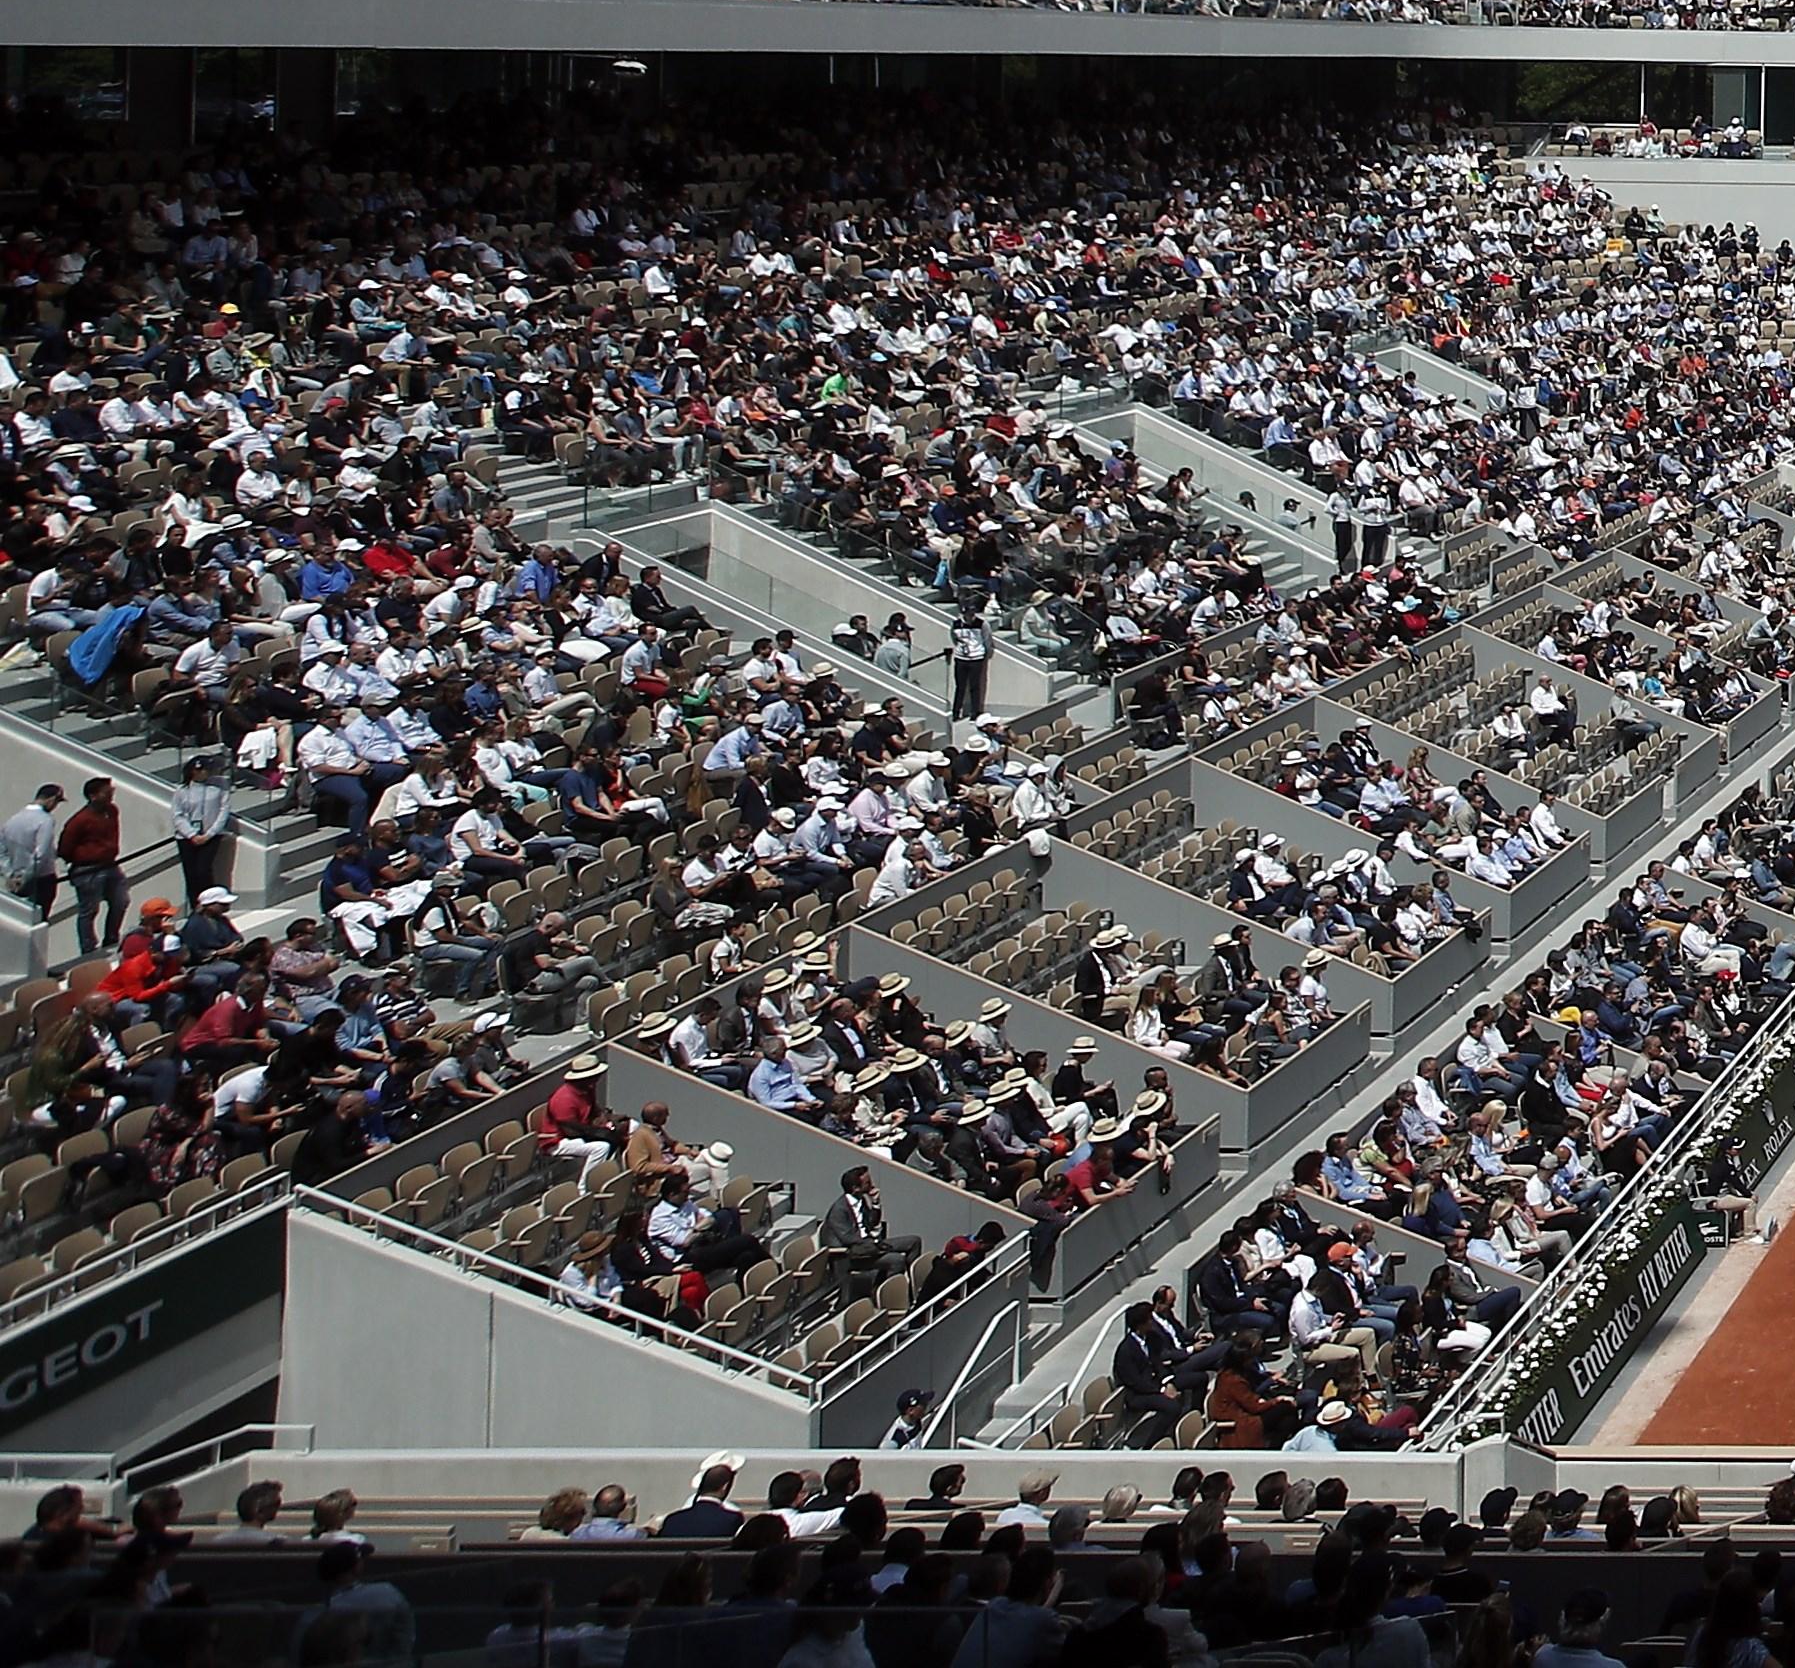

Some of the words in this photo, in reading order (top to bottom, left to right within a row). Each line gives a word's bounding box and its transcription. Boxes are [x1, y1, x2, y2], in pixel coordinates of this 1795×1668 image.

[1763, 1115, 1793, 1162] ROLEX
[1739, 1158, 1761, 1190] LEX
[1567, 1294, 1642, 1399] Emirates
[1637, 1260, 1661, 1310] FLY
[1653, 1222, 1693, 1289] BETTER
